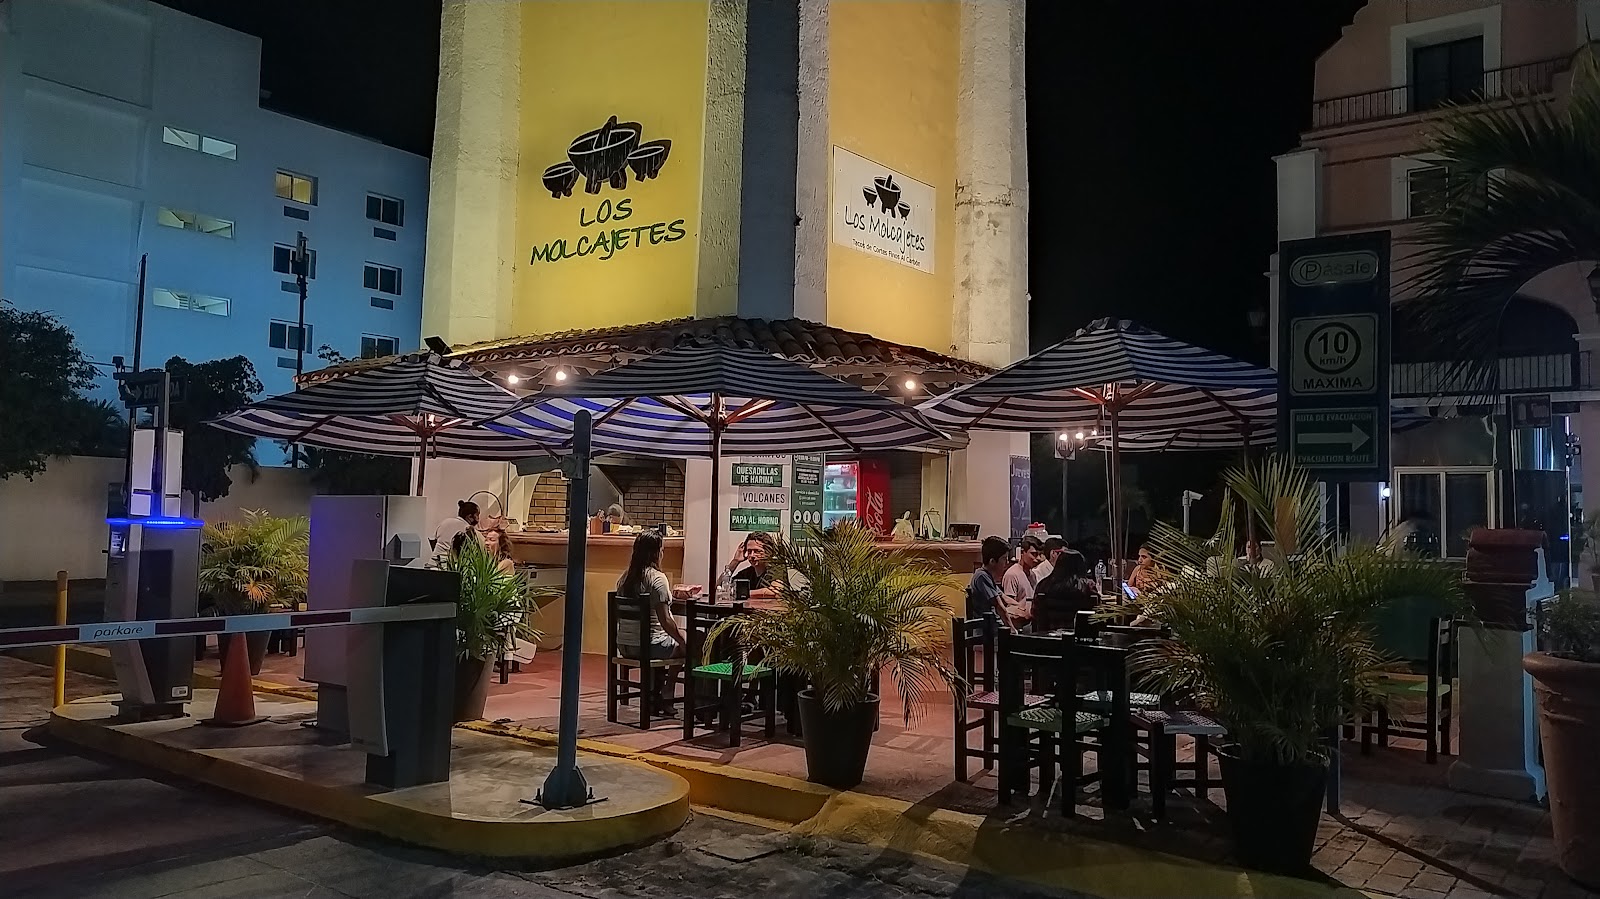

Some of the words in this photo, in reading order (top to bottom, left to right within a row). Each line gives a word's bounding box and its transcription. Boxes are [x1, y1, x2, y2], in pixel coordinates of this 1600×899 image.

[579, 198, 633, 228] LOS
[844, 205, 866, 231] Los
[868, 215, 925, 254] Molcajetes
[529, 219, 686, 266] MOLCAJETES
[852, 238, 866, 249] Tacos
[1317, 331, 1349, 354] 10
[1319, 356, 1347, 366] km/h
[1303, 377, 1363, 390] MAXIMA
[143, 381, 180, 399] ENTDA
[1295, 413, 1314, 422] RUTA
[1315, 413, 1326, 422] DE
[1297, 455, 1345, 463] EVACUATION
[1345, 454, 1370, 463] ROUTE
[736, 466, 779, 476] QUESADILLAS
[740, 475, 749, 484] DE
[750, 475, 774, 485] HARINA
[742, 492, 786, 504] VOLCANES
[731, 515, 748, 524] PAPA
[748, 515, 756, 524] AL
[757, 515, 779, 525] HORNO
[93, 625, 143, 640] parkare
